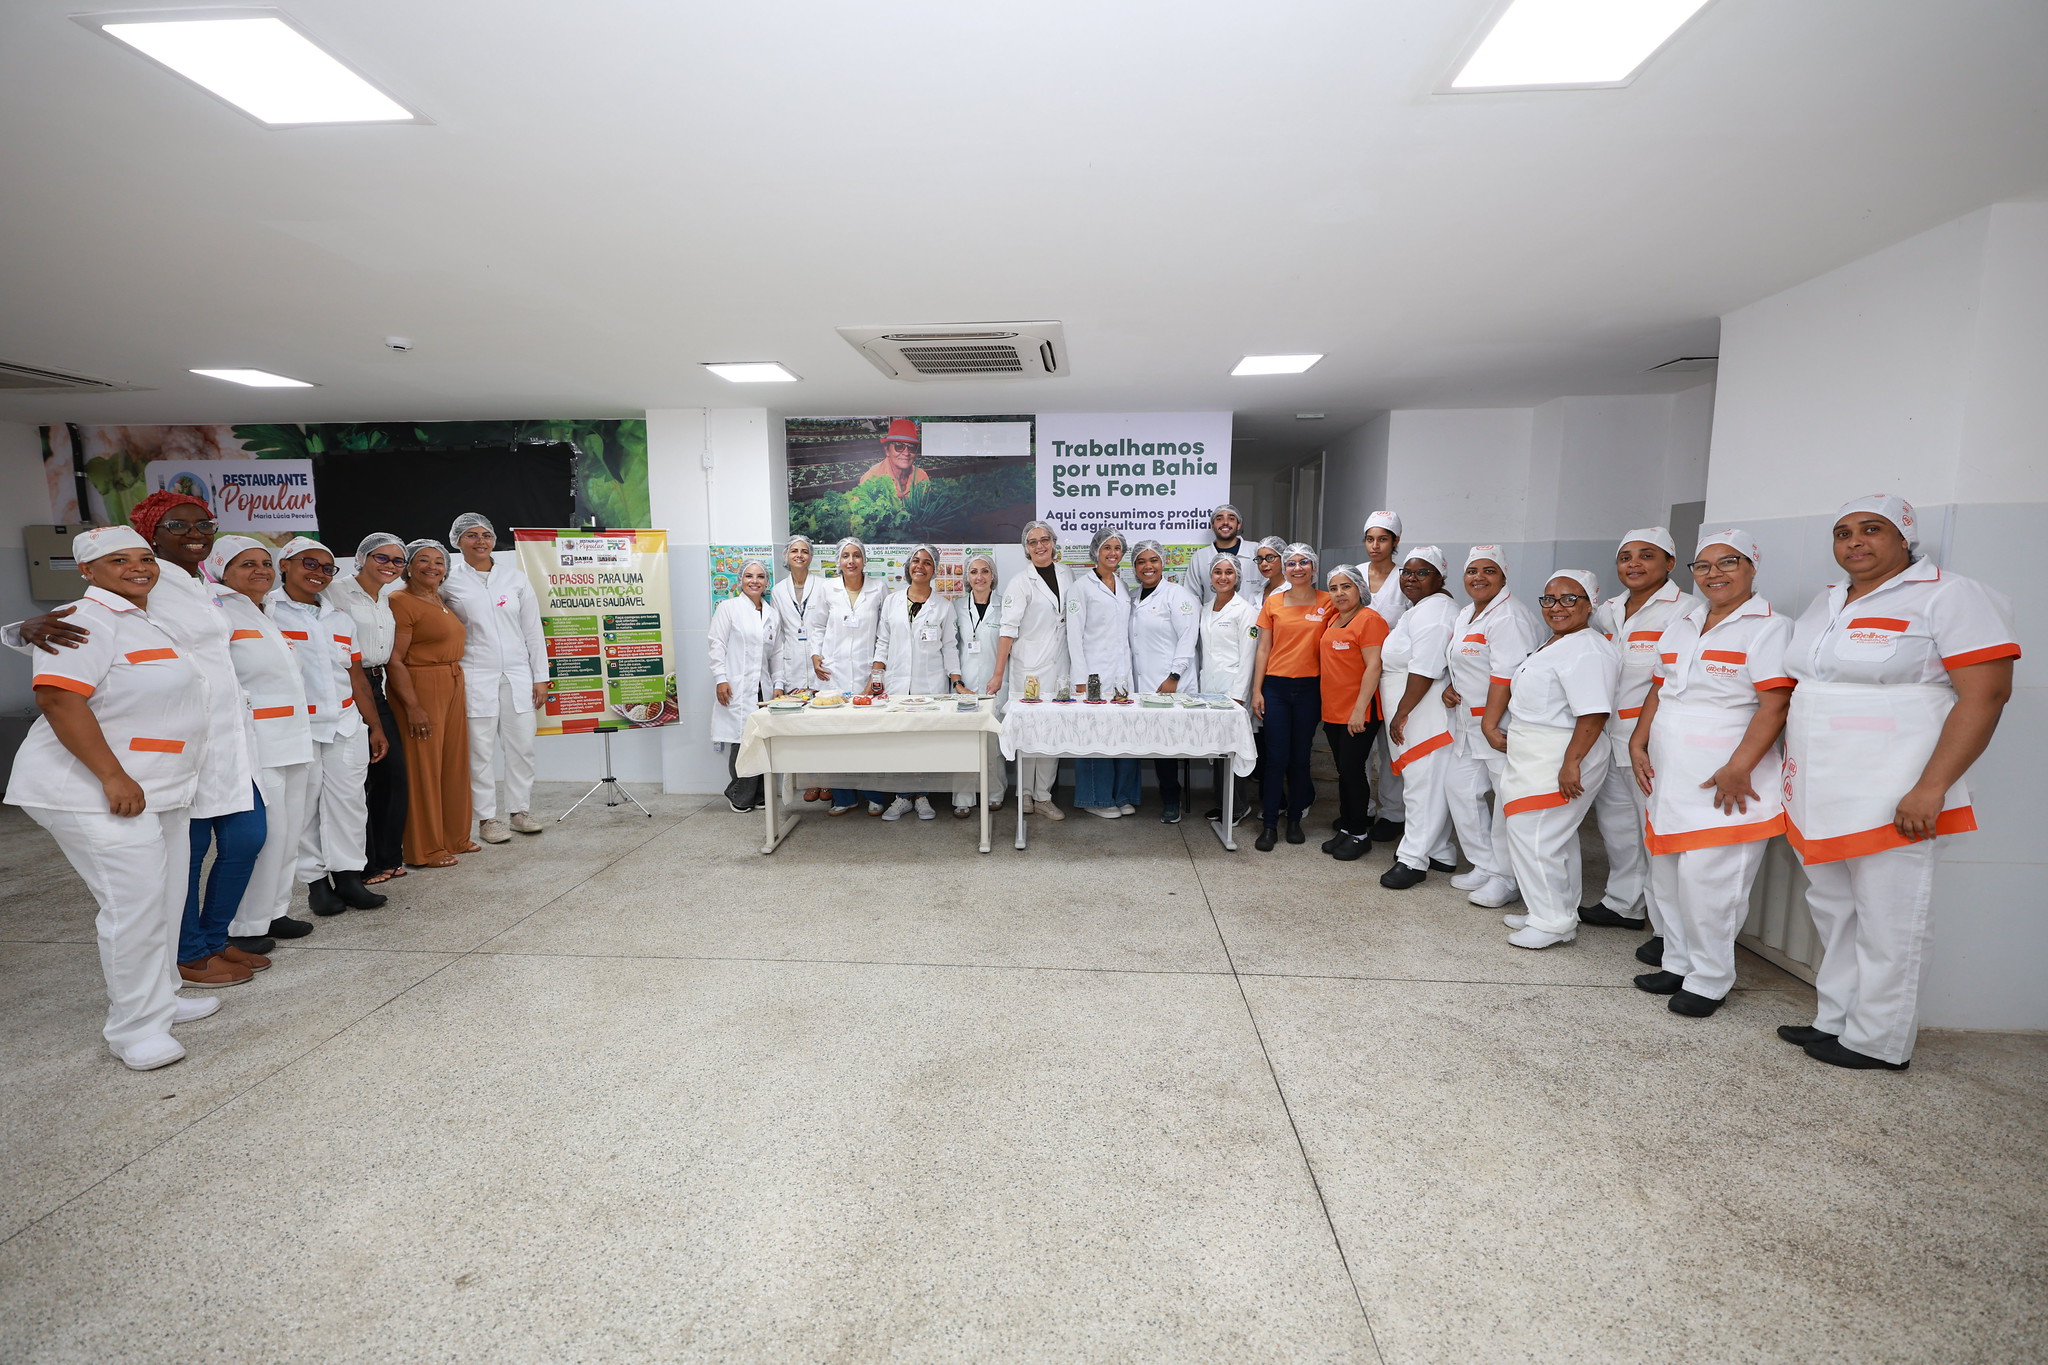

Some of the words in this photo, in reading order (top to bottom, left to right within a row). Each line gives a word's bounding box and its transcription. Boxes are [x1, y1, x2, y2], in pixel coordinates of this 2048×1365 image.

[1051, 438, 1205, 457] Trabalhamos
[1052, 463, 1091, 482] por
[1096, 463, 1146, 477] uma
[1152, 457, 1218, 476] Bahia
[222, 473, 308, 487] RESTAURANTE
[1052, 480, 1101, 498] Sem
[1107, 479, 1176, 497] Fome!
[218, 483, 314, 521] Popular
[1045, 508, 1076, 522] Aqui
[1079, 507, 1165, 520] consumimos
[1167, 507, 1213, 521] produt
[1060, 521, 1078, 531] da
[548, 574, 558, 585] 10
[559, 573, 595, 585] PASSOS
[598, 573, 621, 584] PARA
[622, 572, 644, 584] UMA
[548, 583, 644, 597] ALIMENTAÇÃO
[550, 598, 595, 609] ADEQUADA
[596, 598, 602, 608] E
[602, 595, 646, 608] SAUDÁVEL
